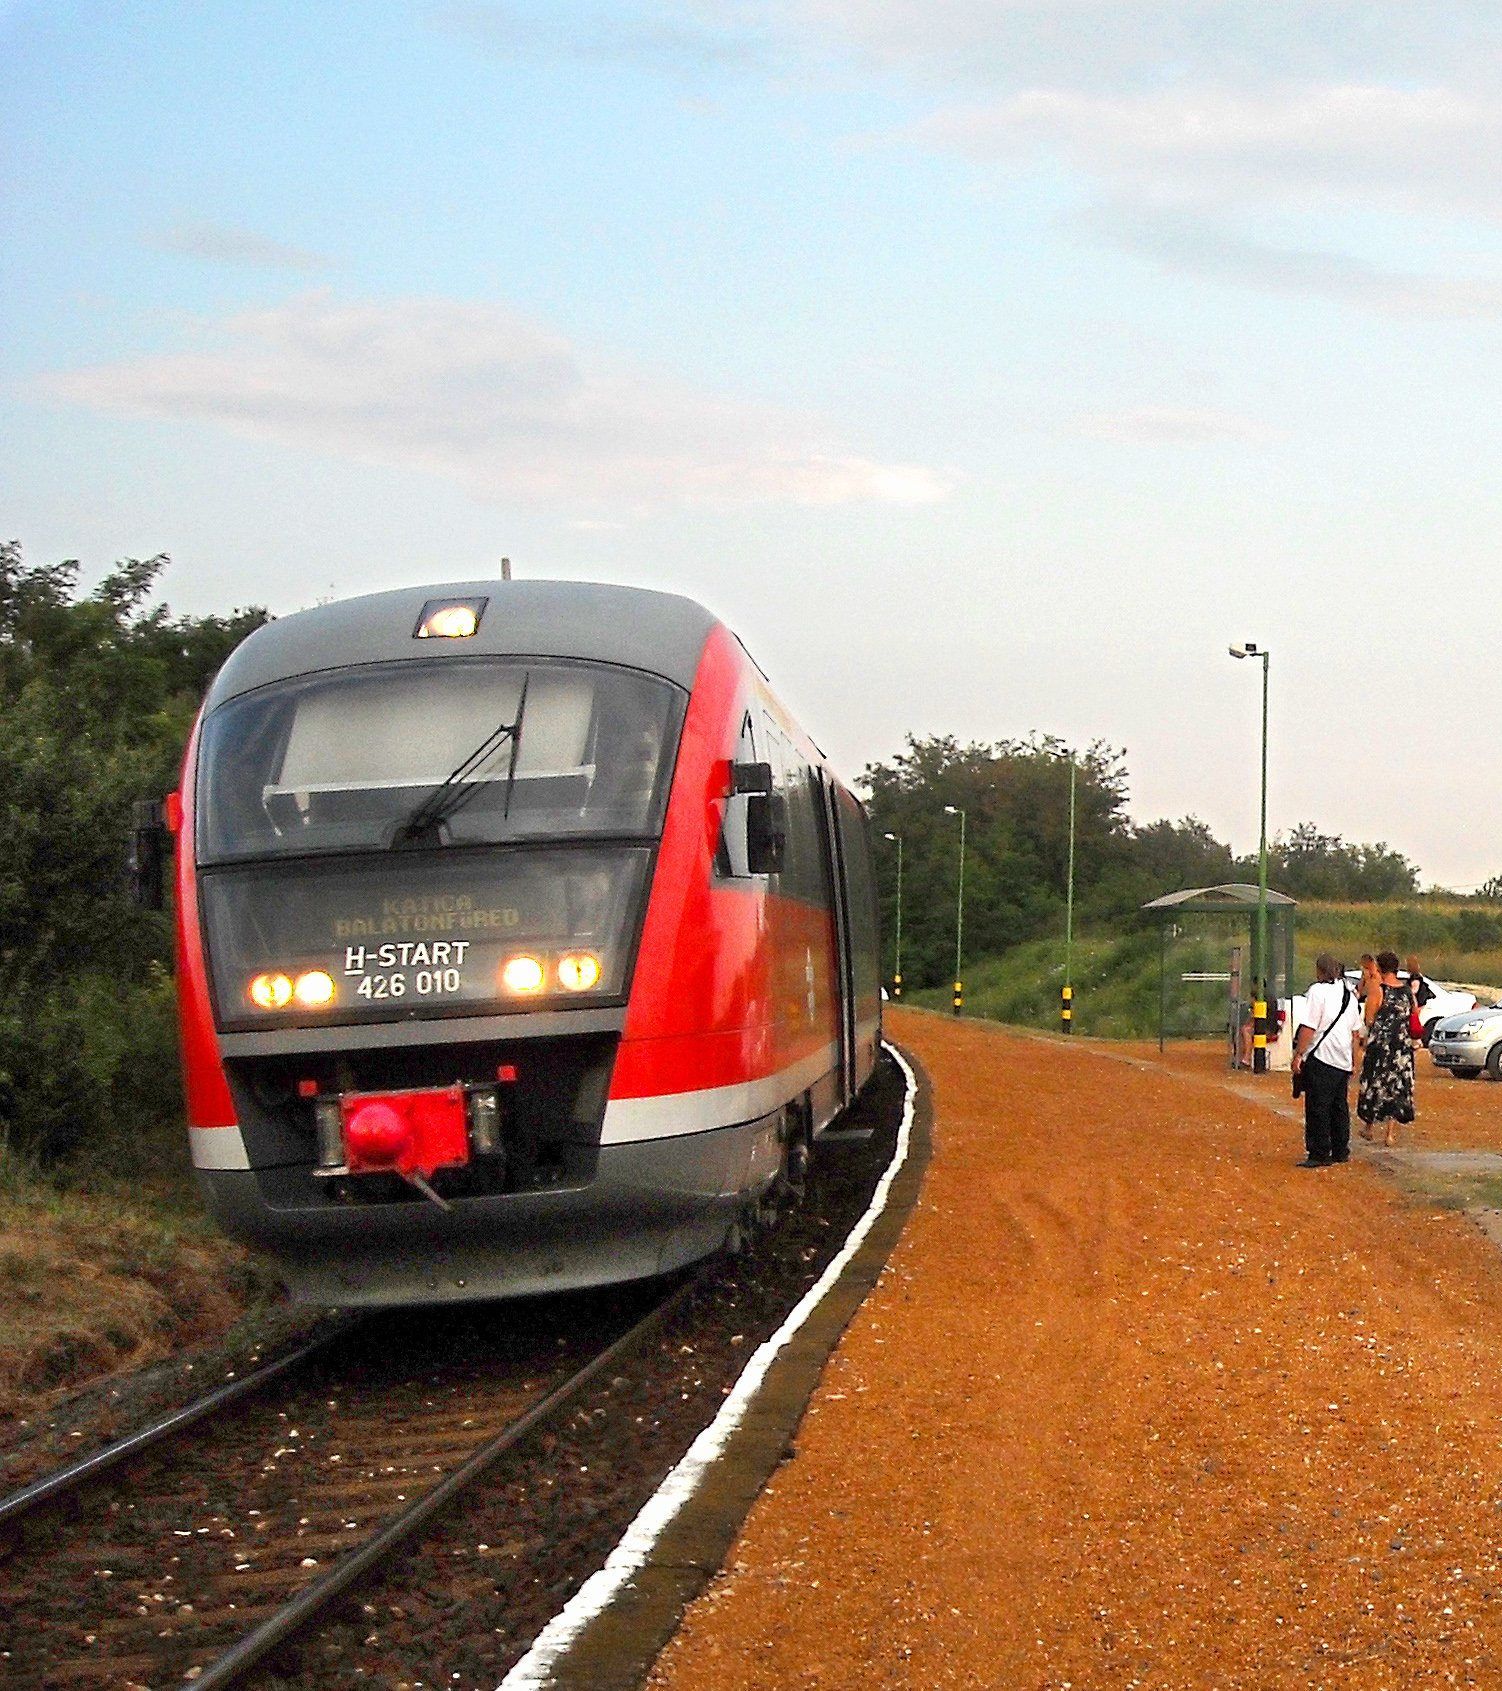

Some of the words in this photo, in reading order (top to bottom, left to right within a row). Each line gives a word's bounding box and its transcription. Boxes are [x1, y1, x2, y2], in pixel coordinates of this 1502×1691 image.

[344, 941, 470, 975] H-START
[357, 973, 406, 1000] 426
[416, 969, 460, 995] 010
